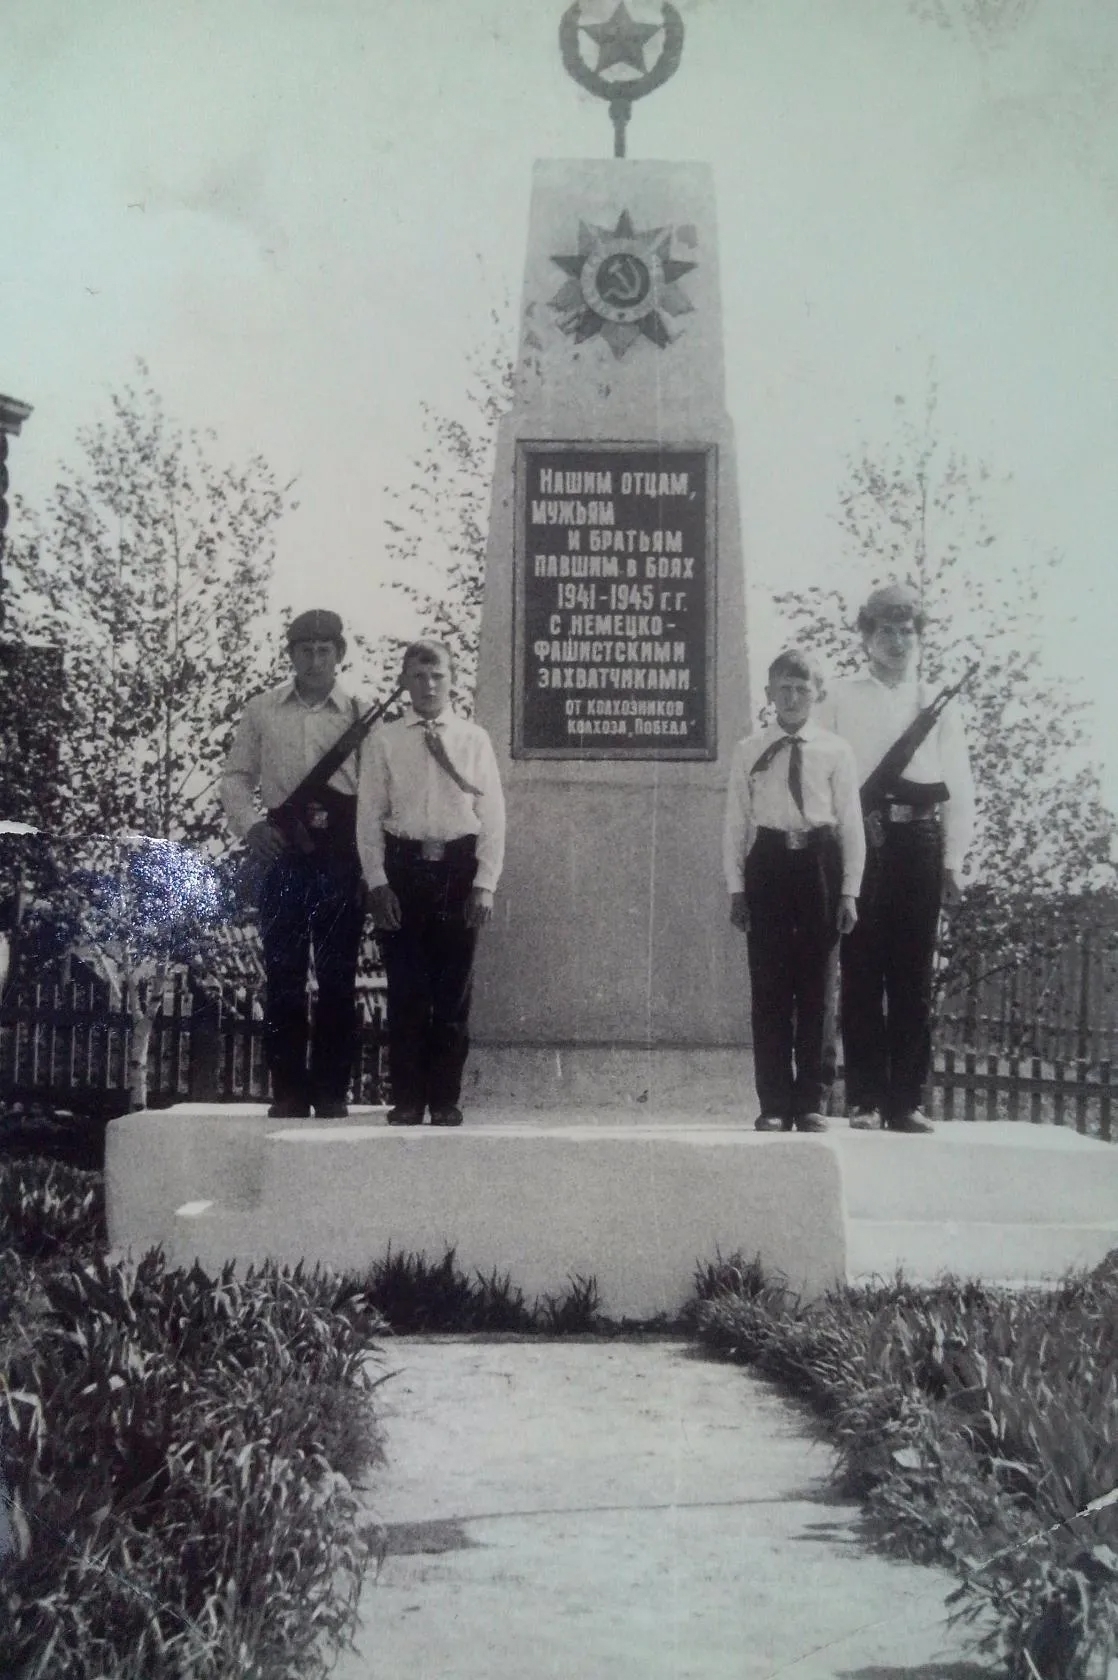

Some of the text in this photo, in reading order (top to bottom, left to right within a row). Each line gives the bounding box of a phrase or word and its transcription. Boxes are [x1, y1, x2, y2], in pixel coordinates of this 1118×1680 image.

[540, 469, 696, 500] НАШИМ ОТЦАМ,
[532, 501, 615, 525] МУЖЬЯМ
[568, 530, 682, 552] И БРАТЬЯМ
[534, 555, 619, 577] ПАВШИМ
[646, 557, 695, 578] БОЯХ
[550, 615, 561, 634] С
[534, 641, 685, 662] ФАШИСТСКИМИ
[565, 699, 684, 716] ОТ КОЛХОЗНИКОВ
[567, 719, 627, 734] КОЛХОЗА
